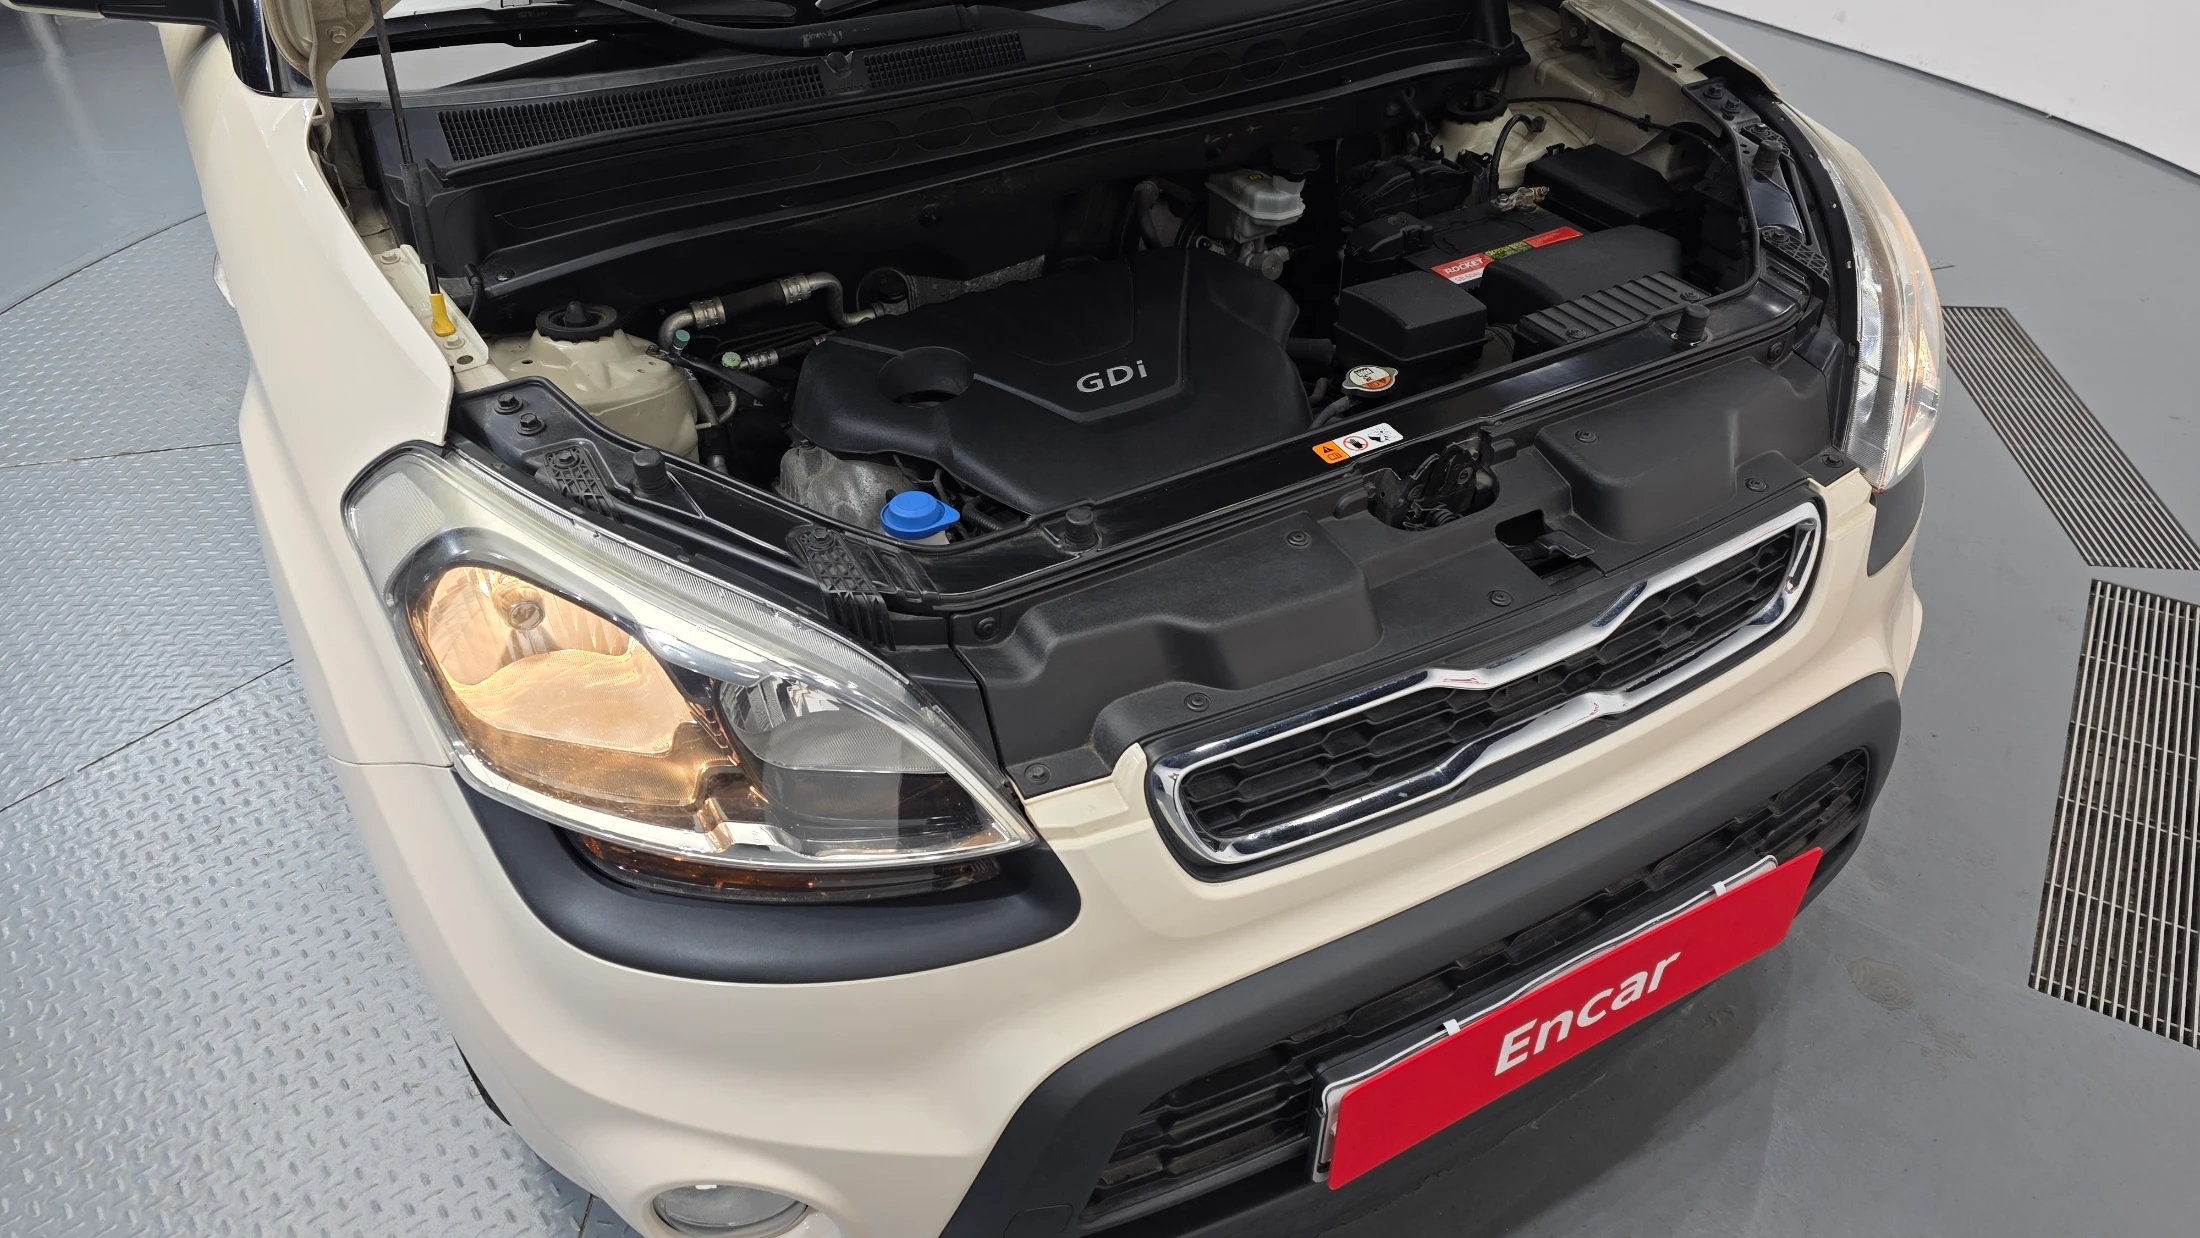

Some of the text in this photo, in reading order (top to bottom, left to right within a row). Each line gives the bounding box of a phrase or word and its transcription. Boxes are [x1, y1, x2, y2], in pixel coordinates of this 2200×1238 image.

[1443, 257, 1483, 274] ROCKET
[1077, 360, 1147, 393] GDi
[1494, 951, 1682, 1076] Encar
